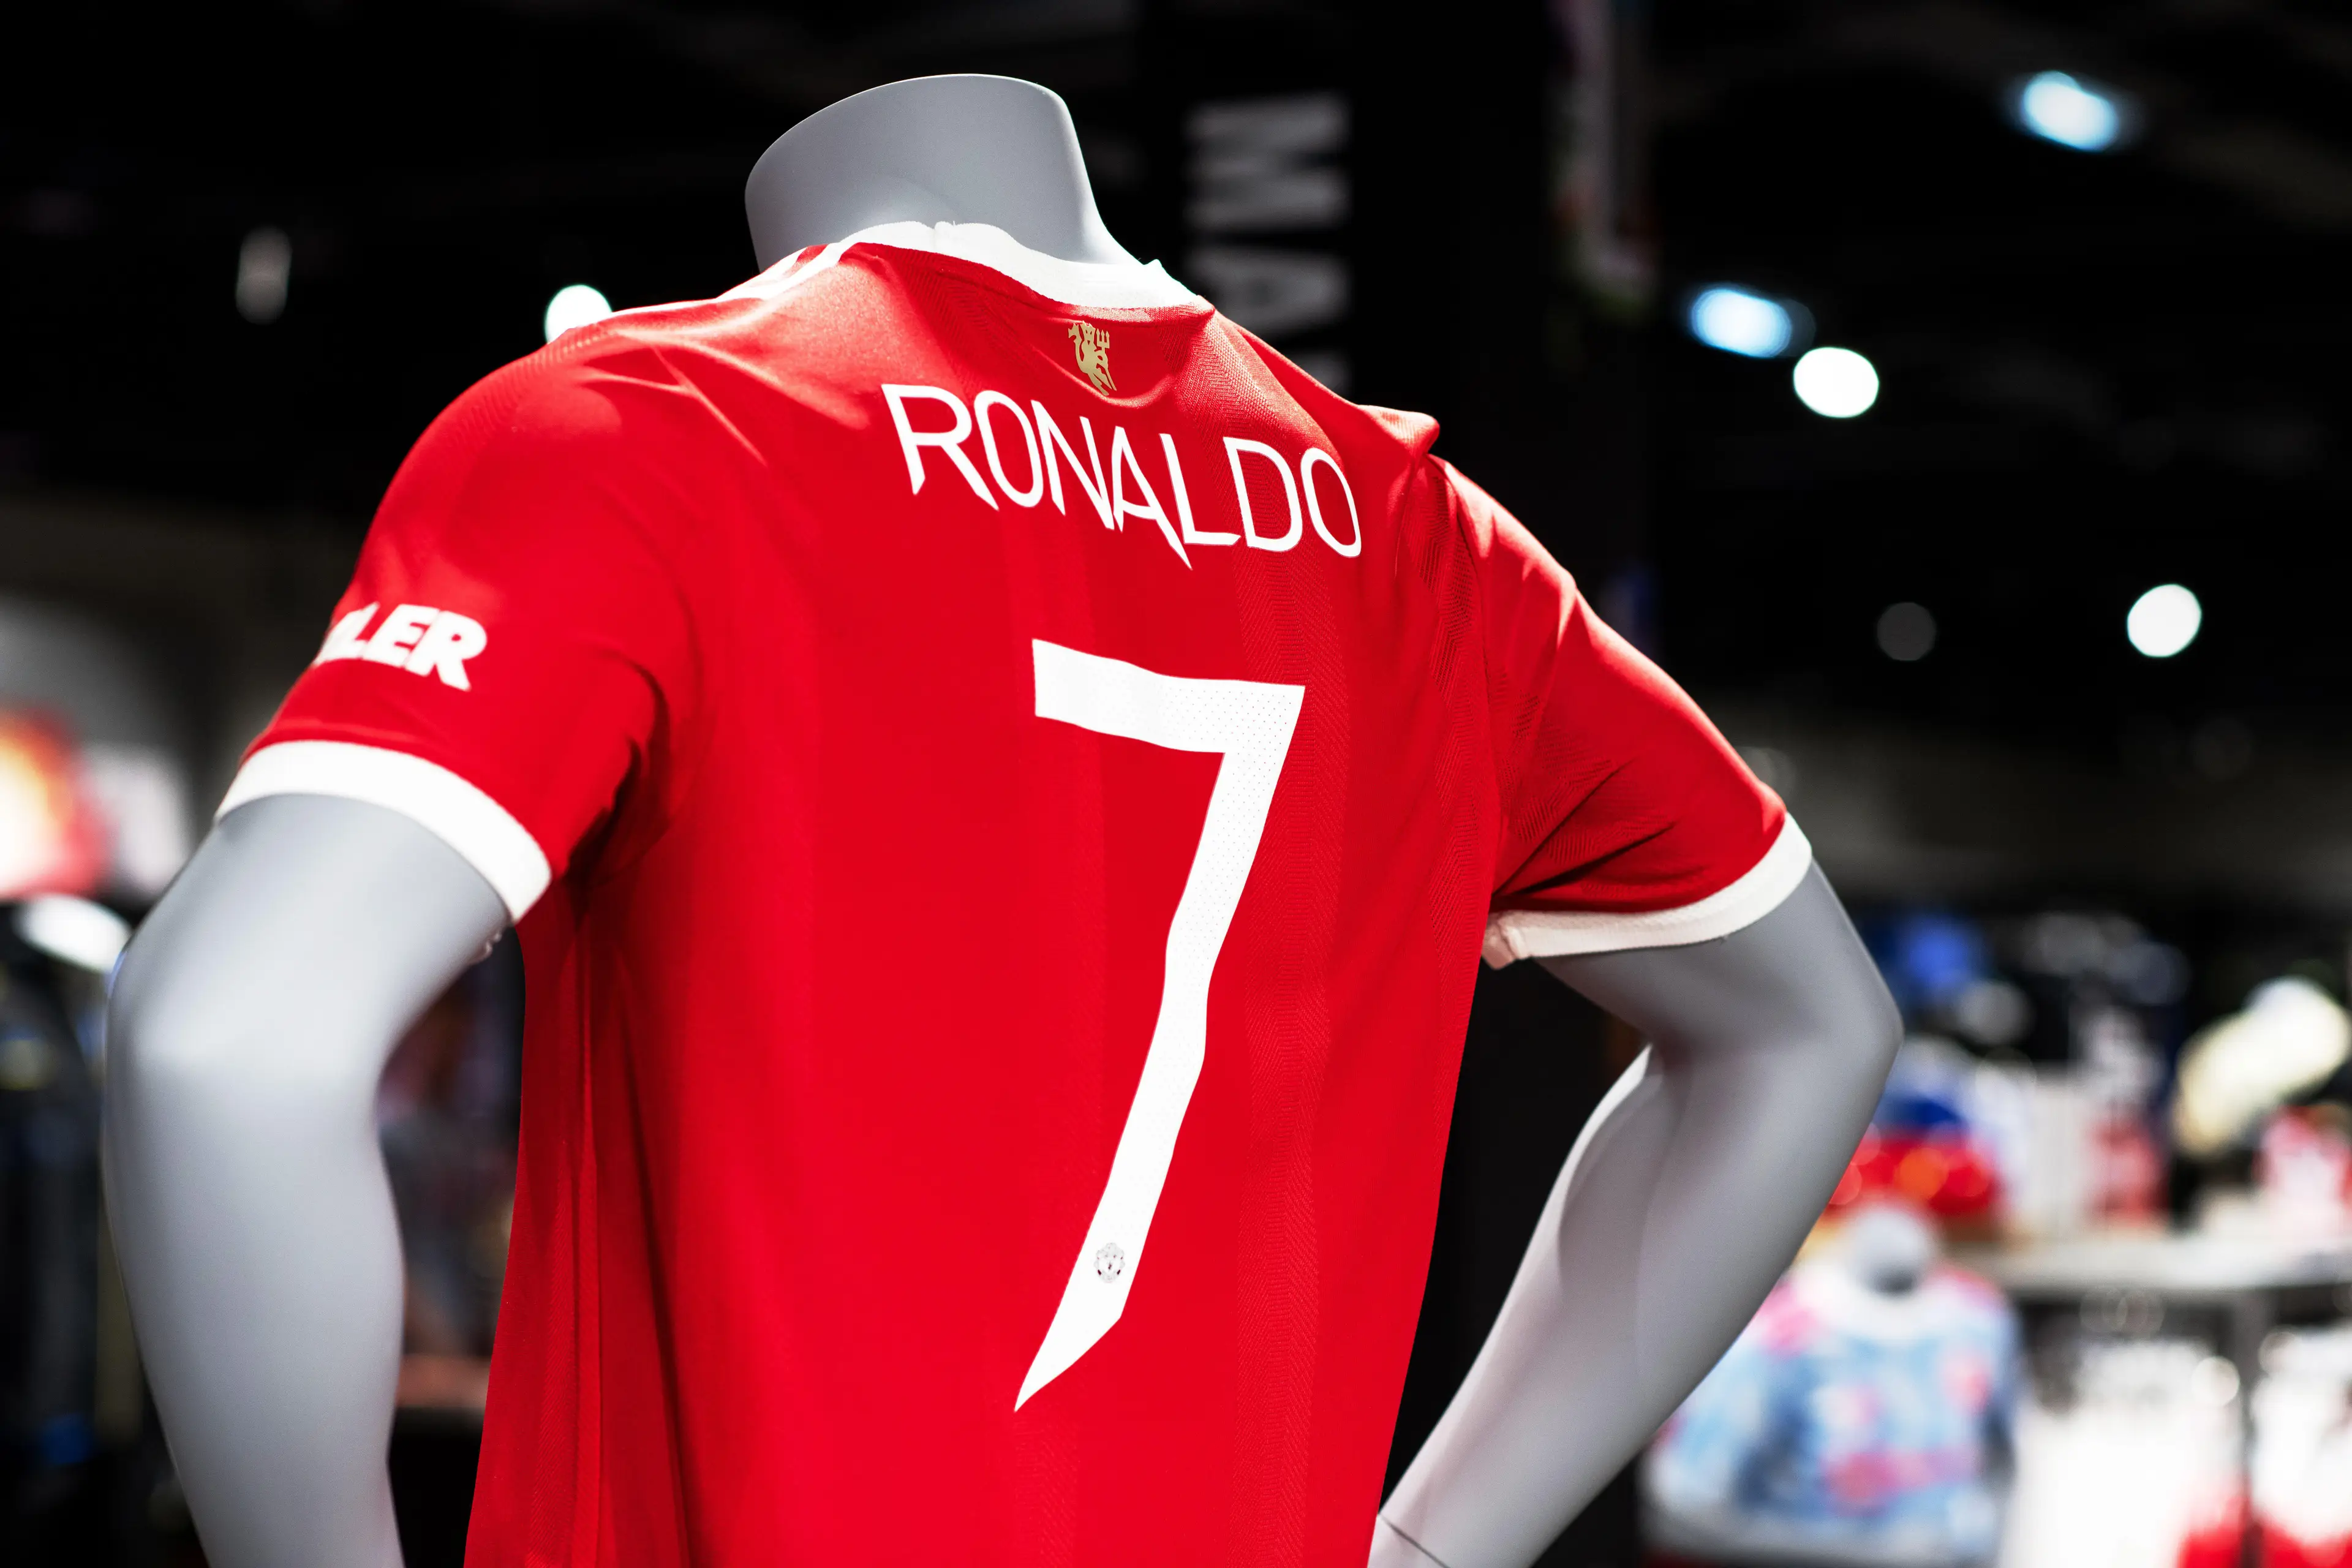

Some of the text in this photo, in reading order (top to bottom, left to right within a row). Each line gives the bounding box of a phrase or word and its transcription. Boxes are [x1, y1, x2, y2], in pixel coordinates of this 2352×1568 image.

[881, 383, 1362, 570] RONALDO
[314, 601, 488, 691] LER
[1014, 639, 1306, 1412] 7
